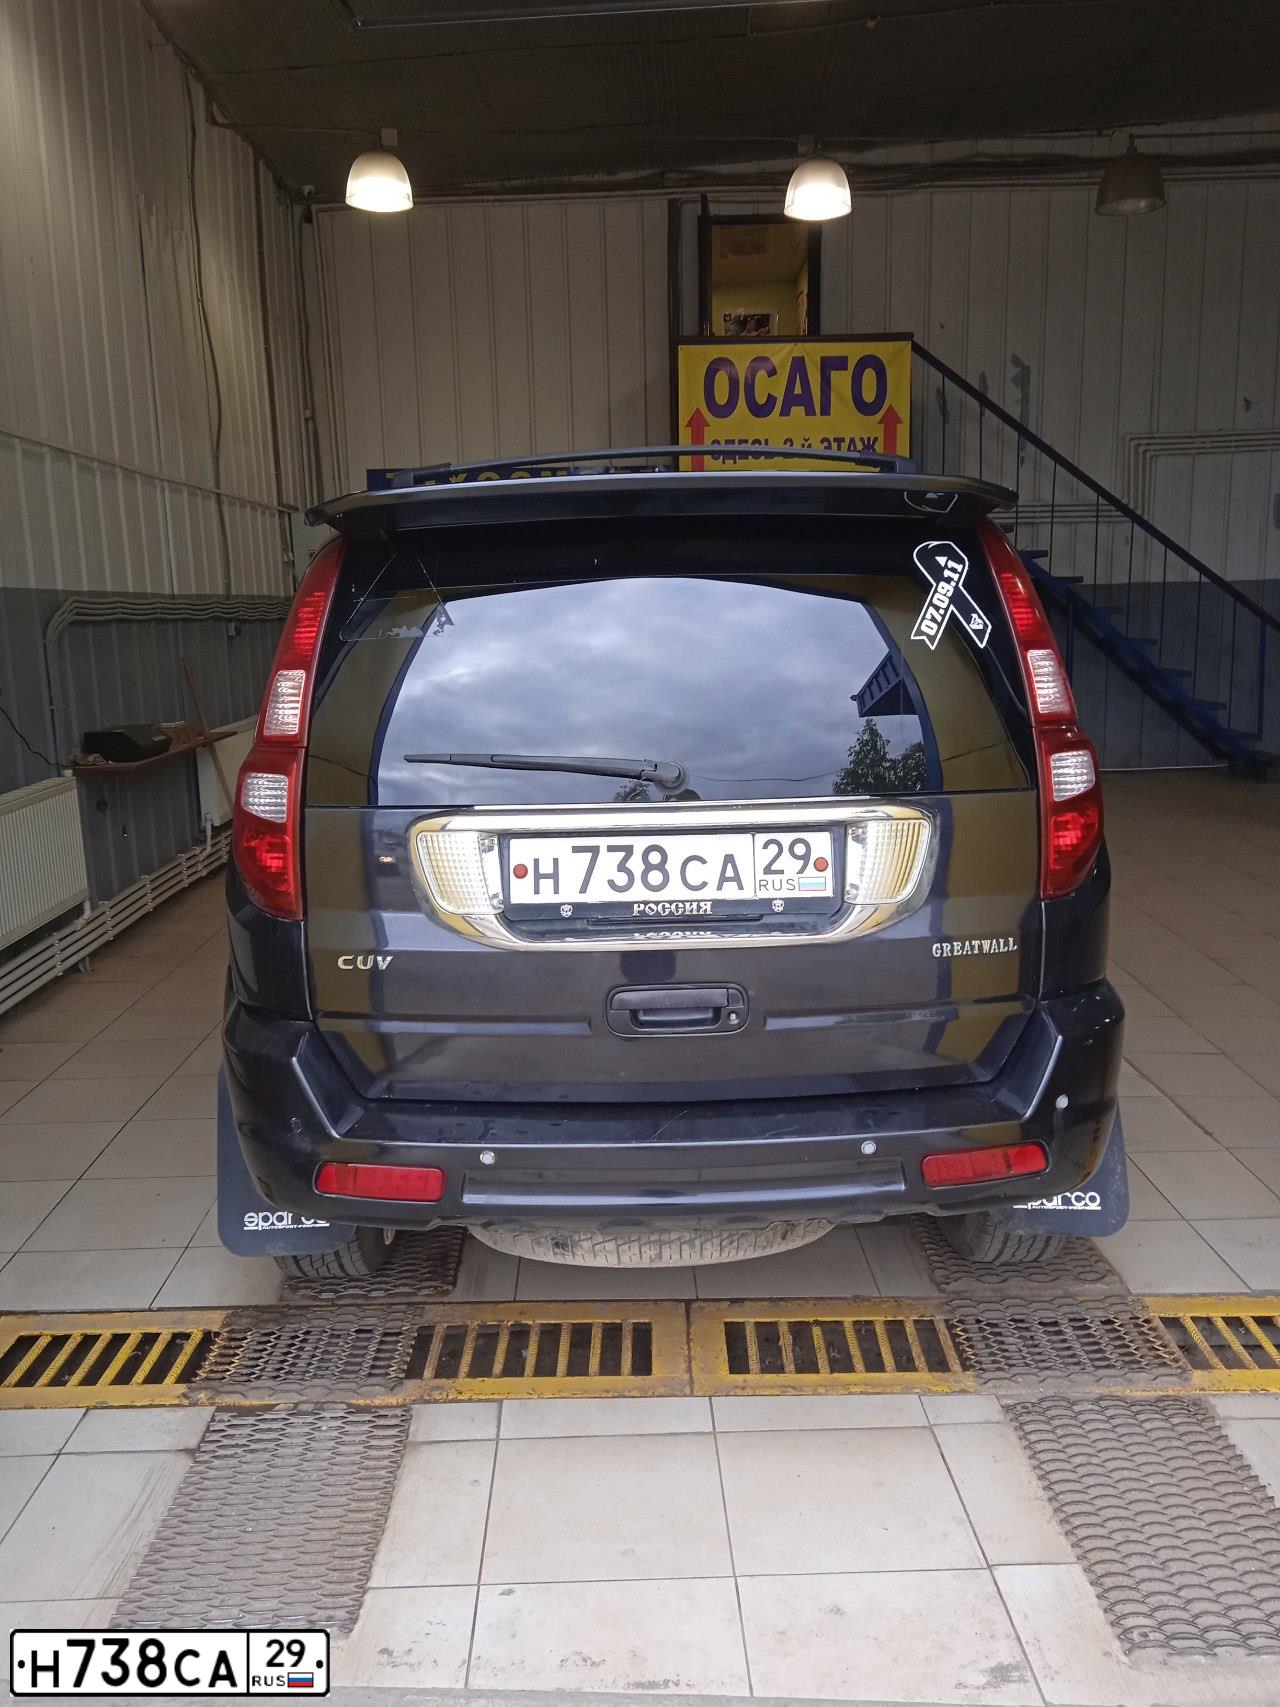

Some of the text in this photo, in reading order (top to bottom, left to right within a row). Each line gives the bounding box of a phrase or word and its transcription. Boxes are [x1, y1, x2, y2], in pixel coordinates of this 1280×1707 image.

[703, 354, 888, 418] ОСАГО
[820, 436, 878, 454] ЭТАЖ
[920, 560, 963, 636] 07.09.11
[533, 837, 811, 895] Н738СА 29
[758, 878, 796, 891] RUS
[633, 901, 713, 916] РОССИЯ
[337, 955, 393, 970] CUV
[1027, 1191, 1101, 1210] arco
